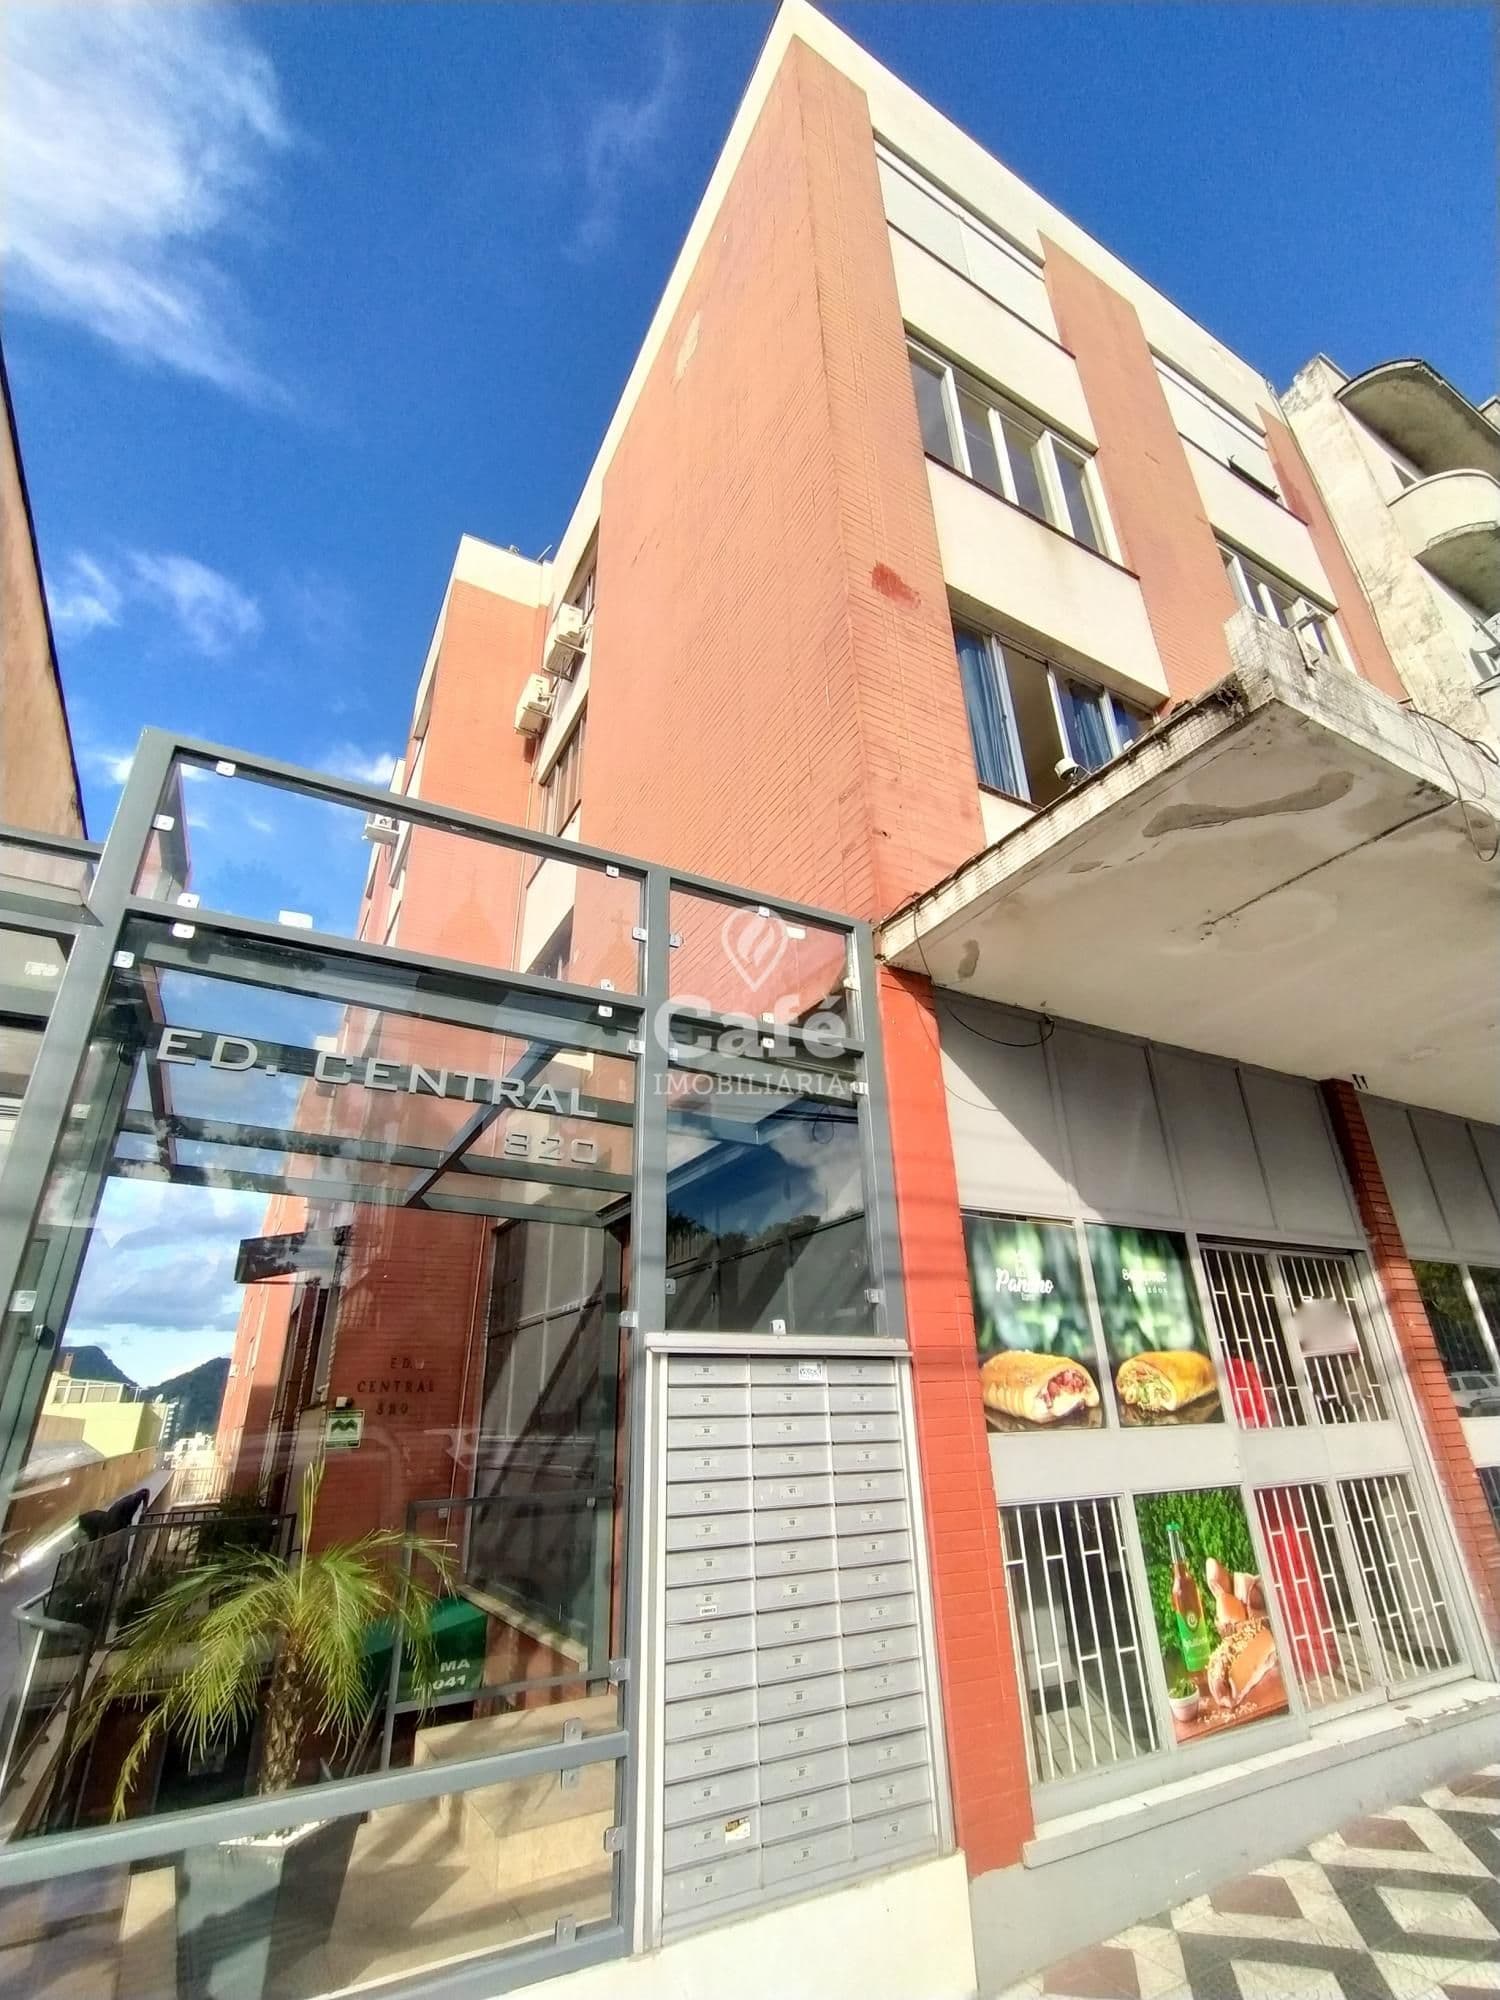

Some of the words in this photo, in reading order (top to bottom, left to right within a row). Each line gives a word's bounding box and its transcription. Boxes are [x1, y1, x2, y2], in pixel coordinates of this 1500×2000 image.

[157, 1027, 277, 1076] ED.
[314, 1051, 598, 1118] CENTRAL
[357, 1380, 434, 1393] CENTRAL
